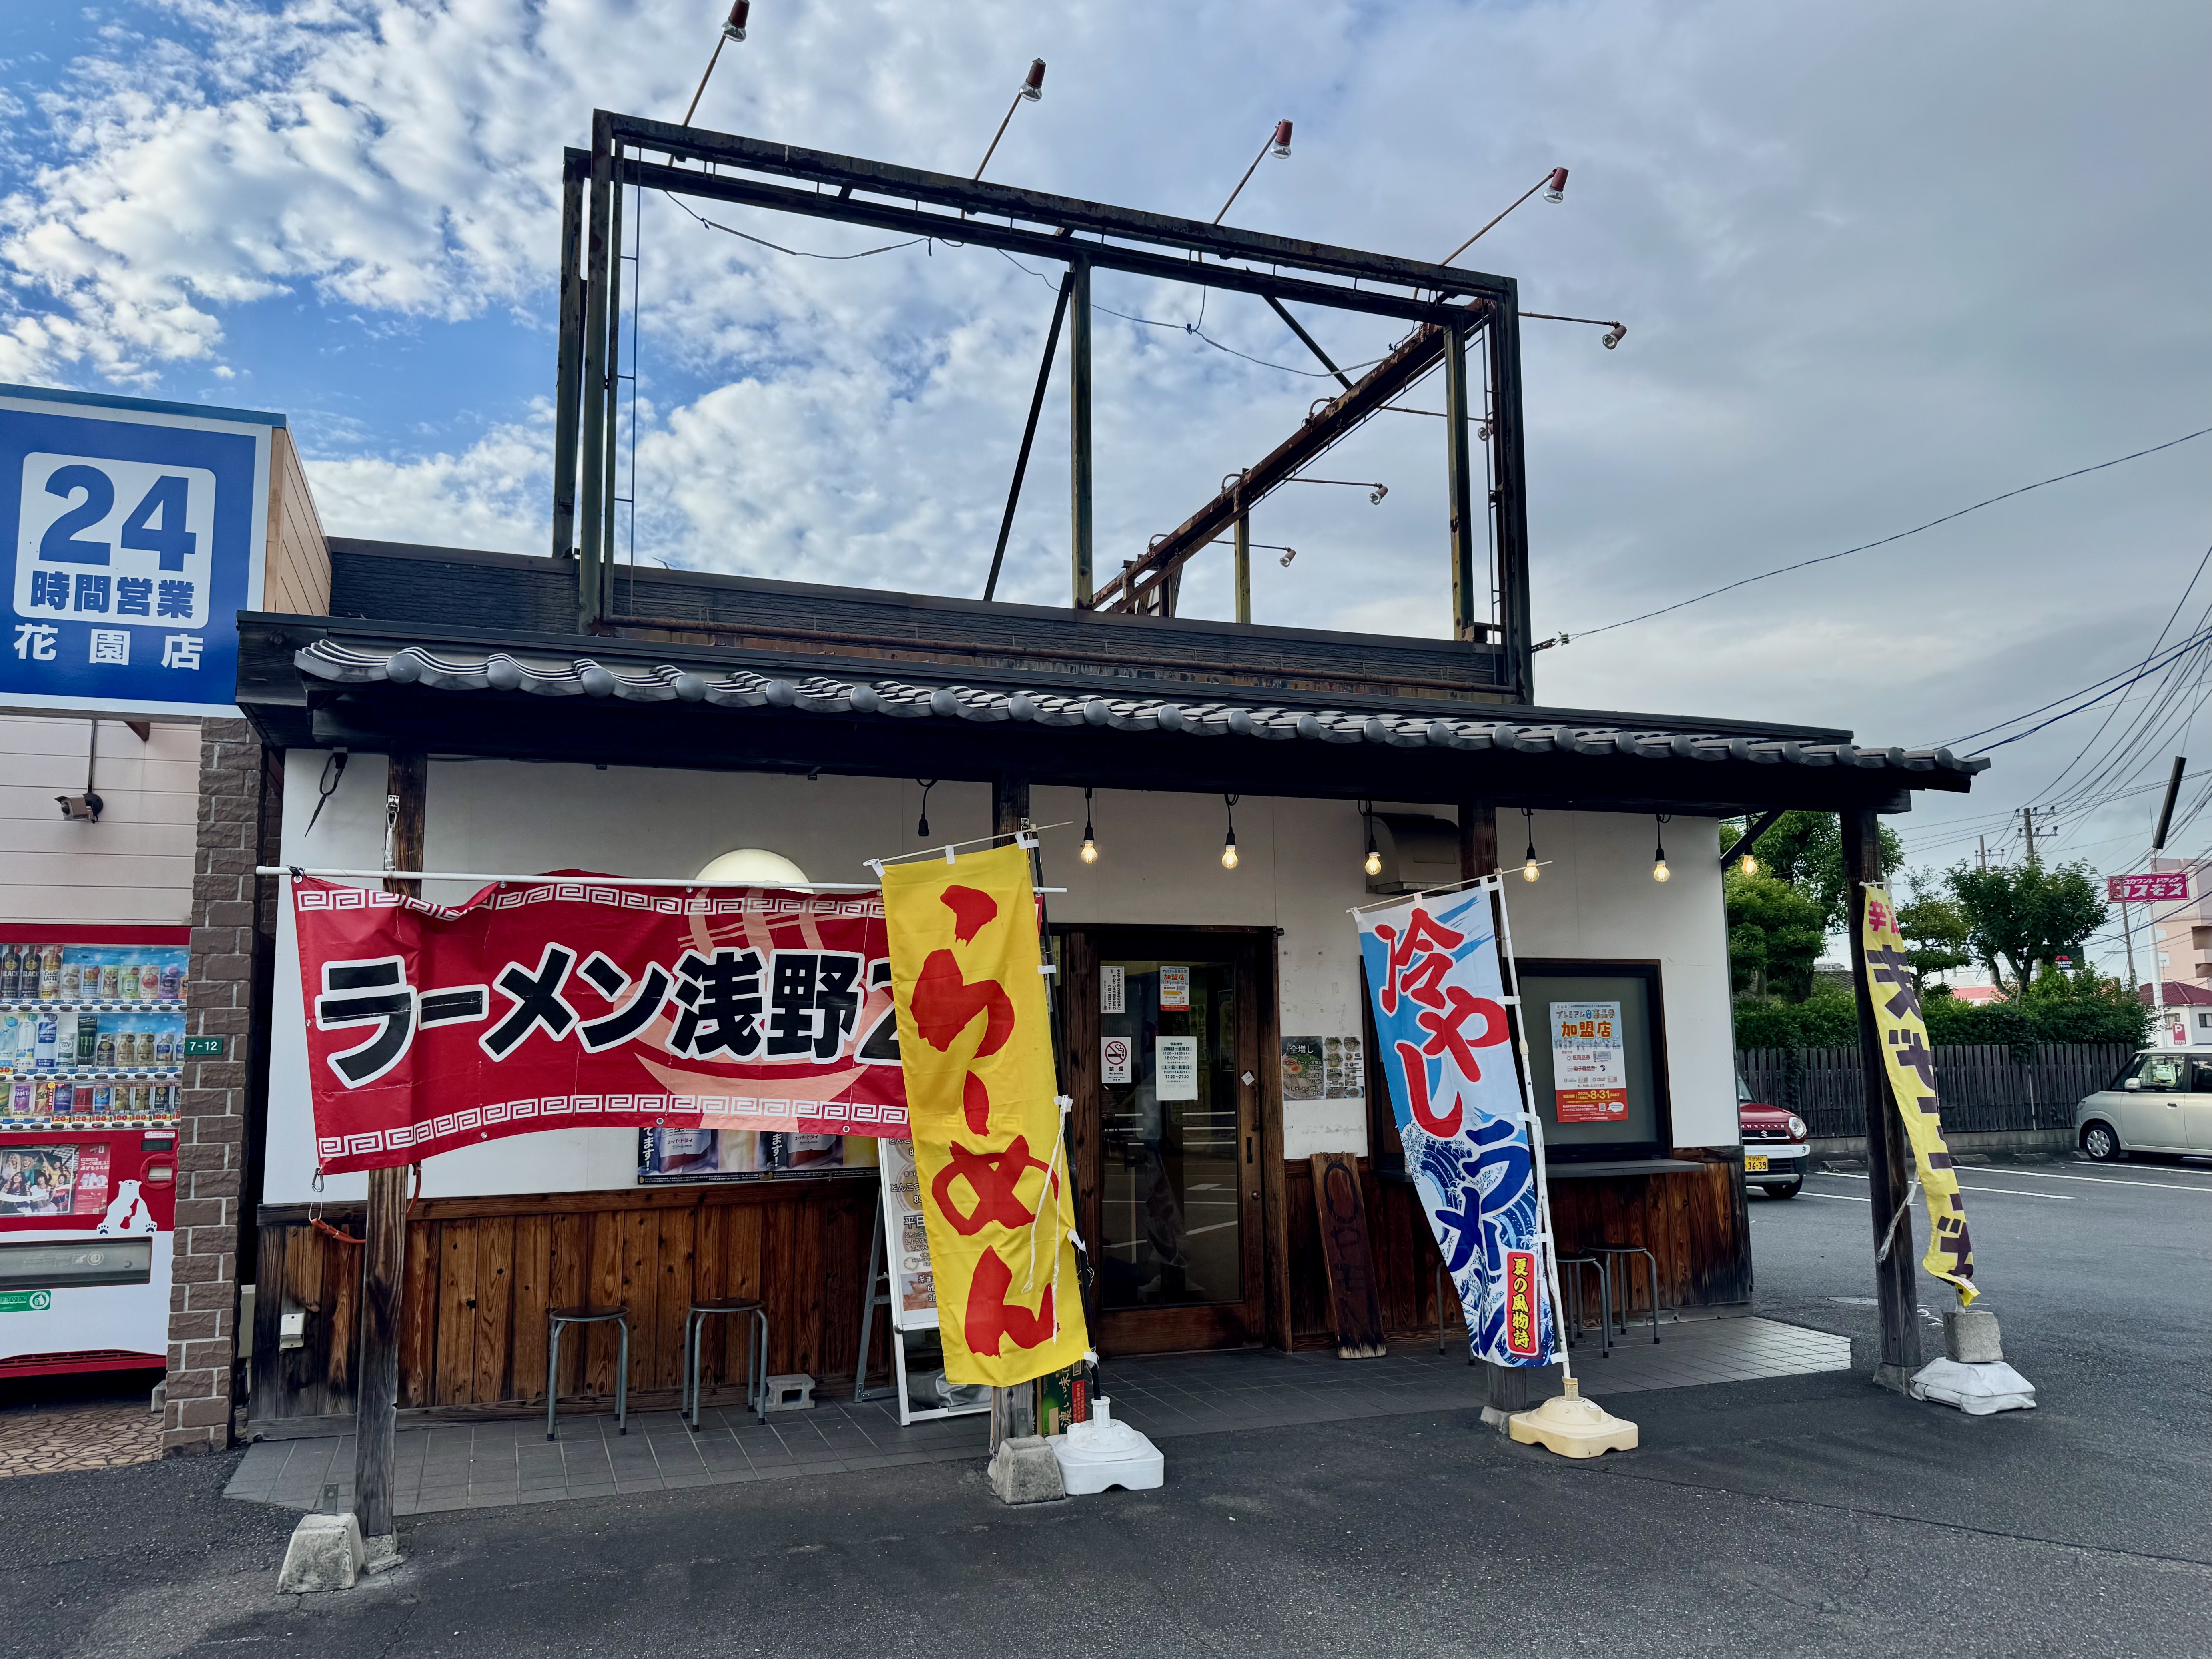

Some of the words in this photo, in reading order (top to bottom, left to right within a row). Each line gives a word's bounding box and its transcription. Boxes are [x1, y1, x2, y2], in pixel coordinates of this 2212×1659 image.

[39, 465, 196, 571] 24
[30, 570, 195, 619] 時間営業
[14, 623, 203, 670] 花園店
[2113, 883, 2184, 898] コスモス
[1374, 907, 1511, 1139] 冷やし
[1561, 1020, 1611, 1037] 加盟店
[2175, 1025, 2183, 1034] P
[190, 1041, 218, 1051] 7-12
[1289, 1045, 1314, 1054] 全増し
[909, 885, 1061, 1358] らーめん
[1748, 1162, 1766, 1170] 36-39
[904, 1215, 925, 1229] 平日
[918, 1275, 934, 1284] ギョ
[1511, 1257, 1530, 1350] 夏の風物詩
[1059, 1372, 1072, 1428] 濃い味
